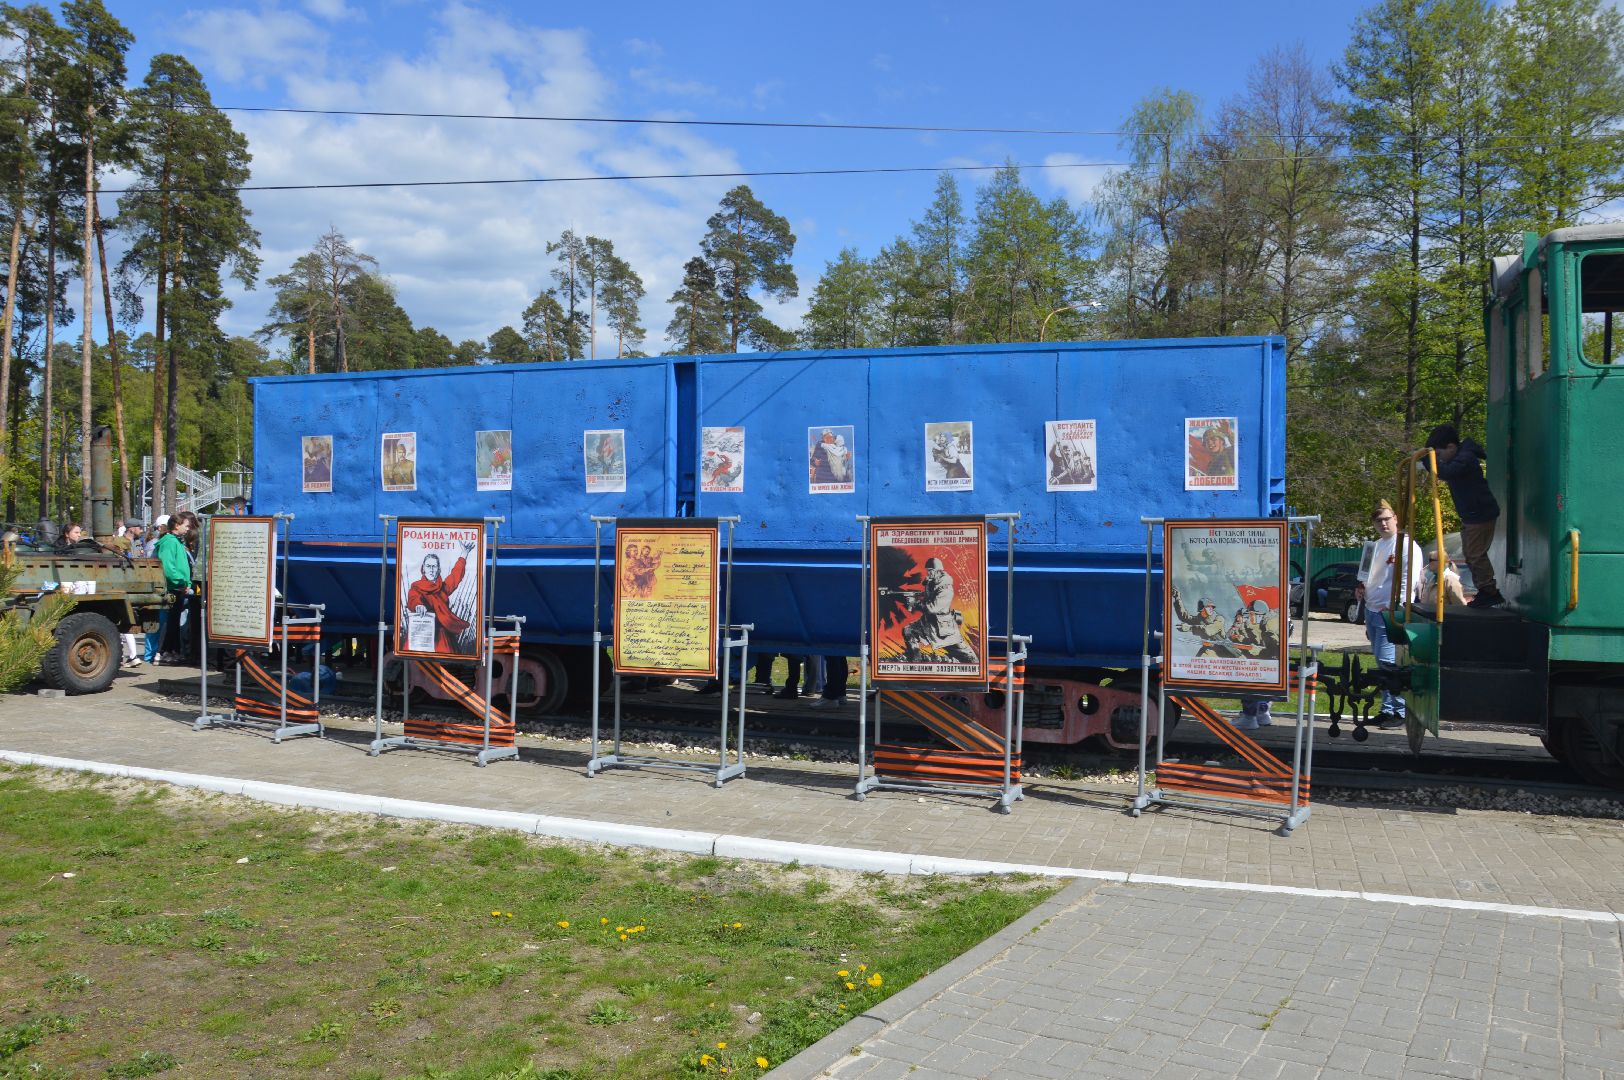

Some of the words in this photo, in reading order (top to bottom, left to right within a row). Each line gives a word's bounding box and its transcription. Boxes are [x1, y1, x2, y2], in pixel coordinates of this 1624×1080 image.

[403, 531, 477, 541] РОДИНА-МАТЬ
[422, 541, 455, 550] ЗОВЕТ!
[878, 664, 900, 672] СМЕРТЬ
[902, 664, 933, 672] НЕМЕЦКИМ
